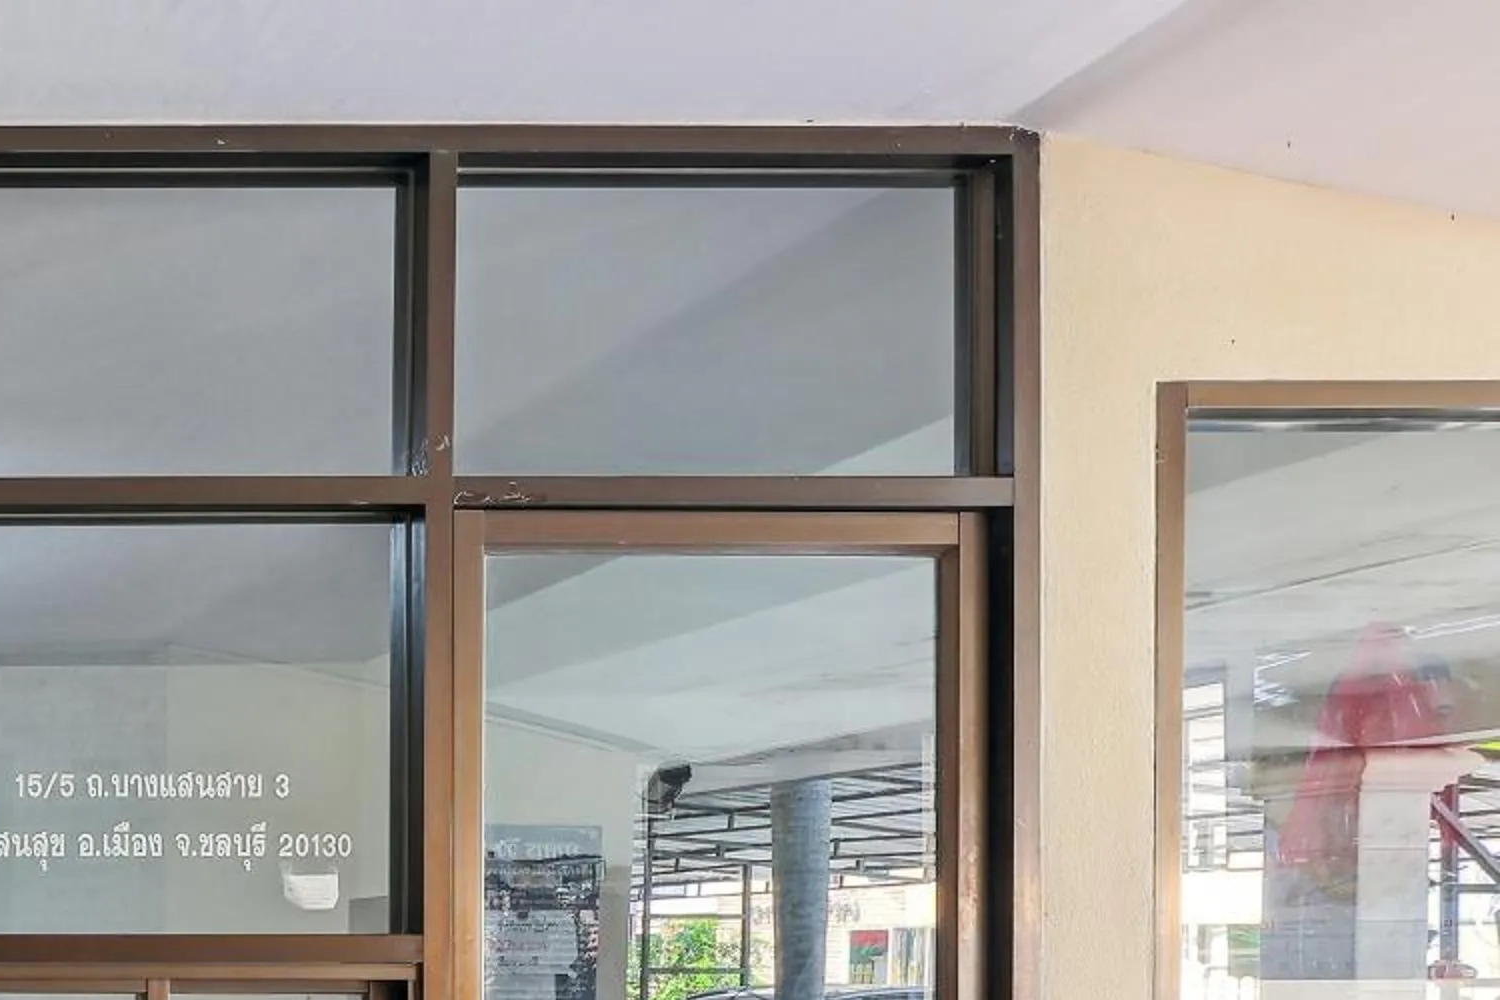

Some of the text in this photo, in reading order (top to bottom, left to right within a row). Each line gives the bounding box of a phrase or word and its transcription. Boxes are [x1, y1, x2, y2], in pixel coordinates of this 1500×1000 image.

[14, 772, 290, 799] 15/5 ถ.บางแสนสาย 3
[78, 821, 163, 860] อ.เมือง
[175, 821, 267, 872] จ.ชลบุรี
[279, 833, 352, 858] 20130
